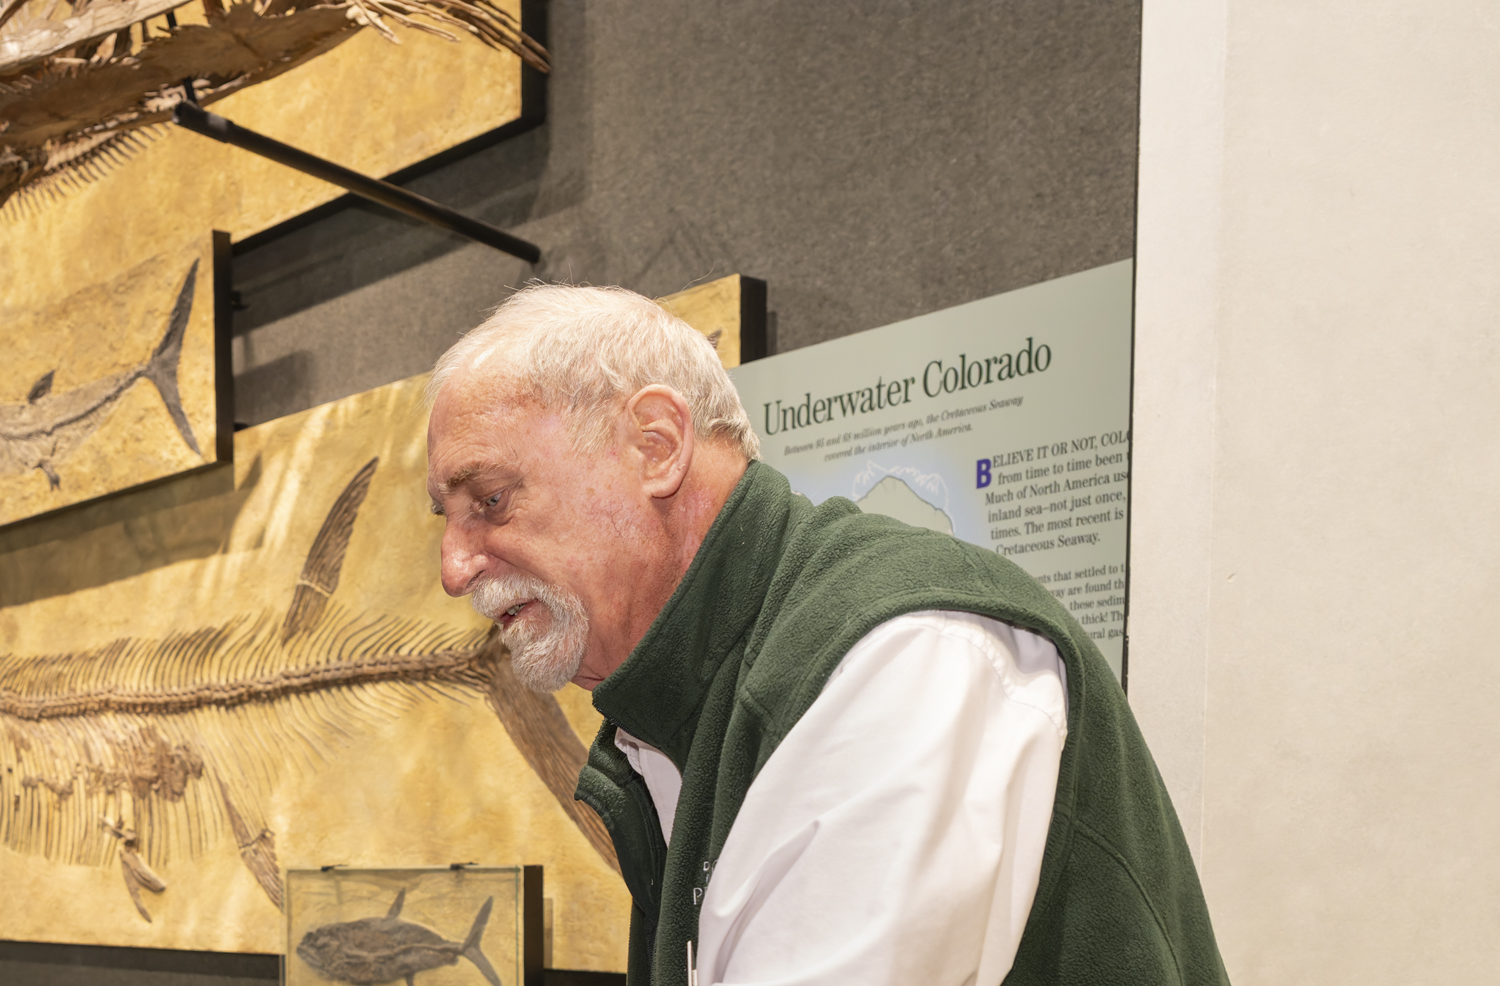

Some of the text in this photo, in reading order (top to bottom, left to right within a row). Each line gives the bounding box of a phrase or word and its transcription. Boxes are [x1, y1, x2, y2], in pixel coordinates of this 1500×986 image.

[763, 336, 1052, 436] Underwater Colorado
[826, 434, 841, 446] and
[853, 426, 882, 440] million
[884, 422, 906, 436] years
[926, 413, 939, 424] the
[941, 404, 987, 421] Cretaceous
[989, 396, 1023, 411] Seaway
[854, 444, 866, 454] the
[868, 438, 898, 452] interior
[901, 434, 910, 447] of
[910, 430, 934, 443] North
[935, 423, 973, 438] America.
[1036, 445, 1049, 460] IT
[1051, 441, 1068, 456] OR
[1070, 435, 1097, 453] NOT,
[998, 472, 1022, 485] from
[1025, 466, 1050, 480] time
[1053, 463, 1064, 474] to
[1067, 458, 1092, 472] time
[1095, 452, 1123, 467] been
[985, 490, 1013, 506] Much
[1016, 485, 1028, 499] of
[1029, 481, 1060, 498] North
[1063, 474, 1110, 492] America
[988, 505, 1022, 523] inland
[1070, 495, 1092, 512] just
[1095, 490, 1126, 505] once,
[990, 507, 1124, 540] times. The most recent is
[996, 531, 1101, 556] Cretaceous Seaway.
[1053, 571, 1072, 582] that
[1074, 565, 1106, 579] settled
[1108, 565, 1118, 574] to
[1067, 585, 1082, 596] are
[1085, 580, 1112, 594] found
[1069, 600, 1094, 611] these
[1081, 612, 1108, 625] thick!
